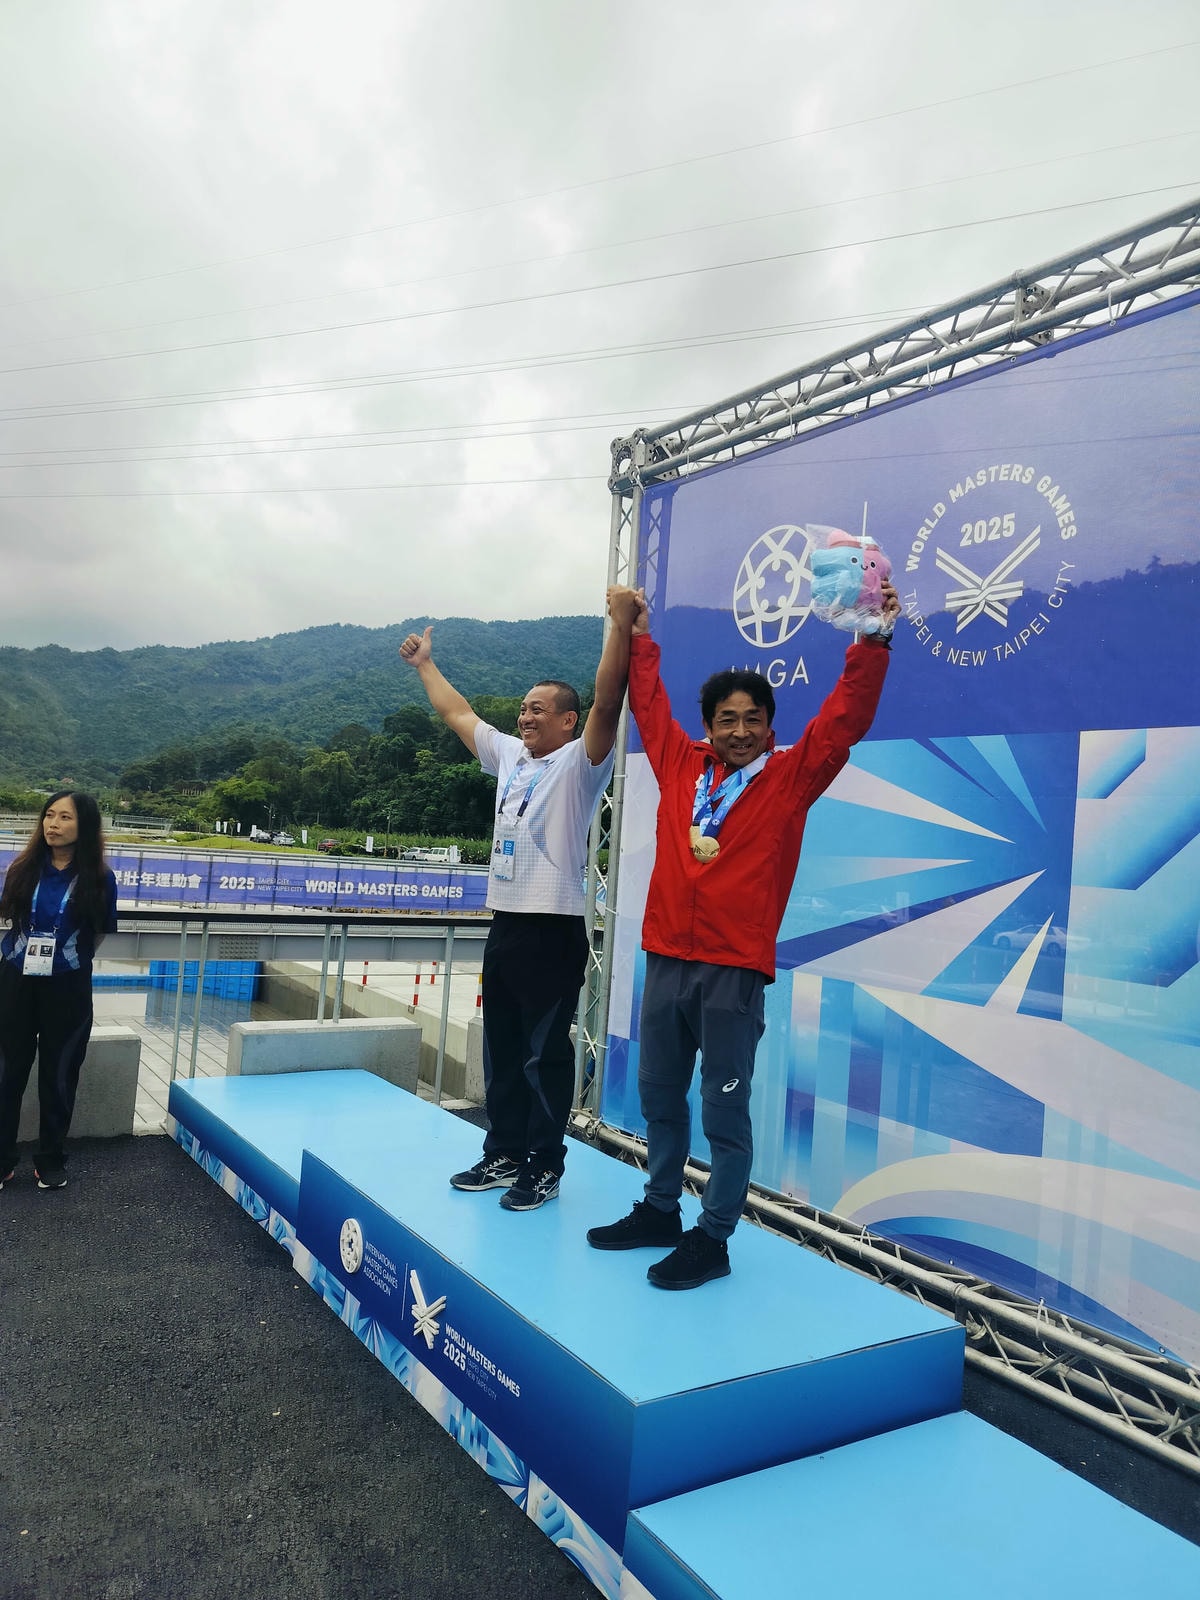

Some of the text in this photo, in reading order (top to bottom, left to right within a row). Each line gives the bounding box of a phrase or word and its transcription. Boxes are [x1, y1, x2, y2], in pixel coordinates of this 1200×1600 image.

[905, 463, 1077, 572] WORLD MASTERS GAMES
[960, 512, 1015, 547] 2025
[904, 560, 1076, 667] TAIPEI & NEW TAIPEI CITY
[731, 655, 809, 688] GA
[219, 876, 256, 890] 2025
[305, 880, 463, 898] WORLD MASTERS GAMES
[364, 1253, 398, 1289] MASTERS GAMES
[365, 1240, 397, 1275] INTERNATIONAL
[363, 1265, 391, 1296] ASSOCIATION
[443, 1338, 466, 1371] 2025
[445, 1322, 520, 1397] WORLD MASTERS GAMES
